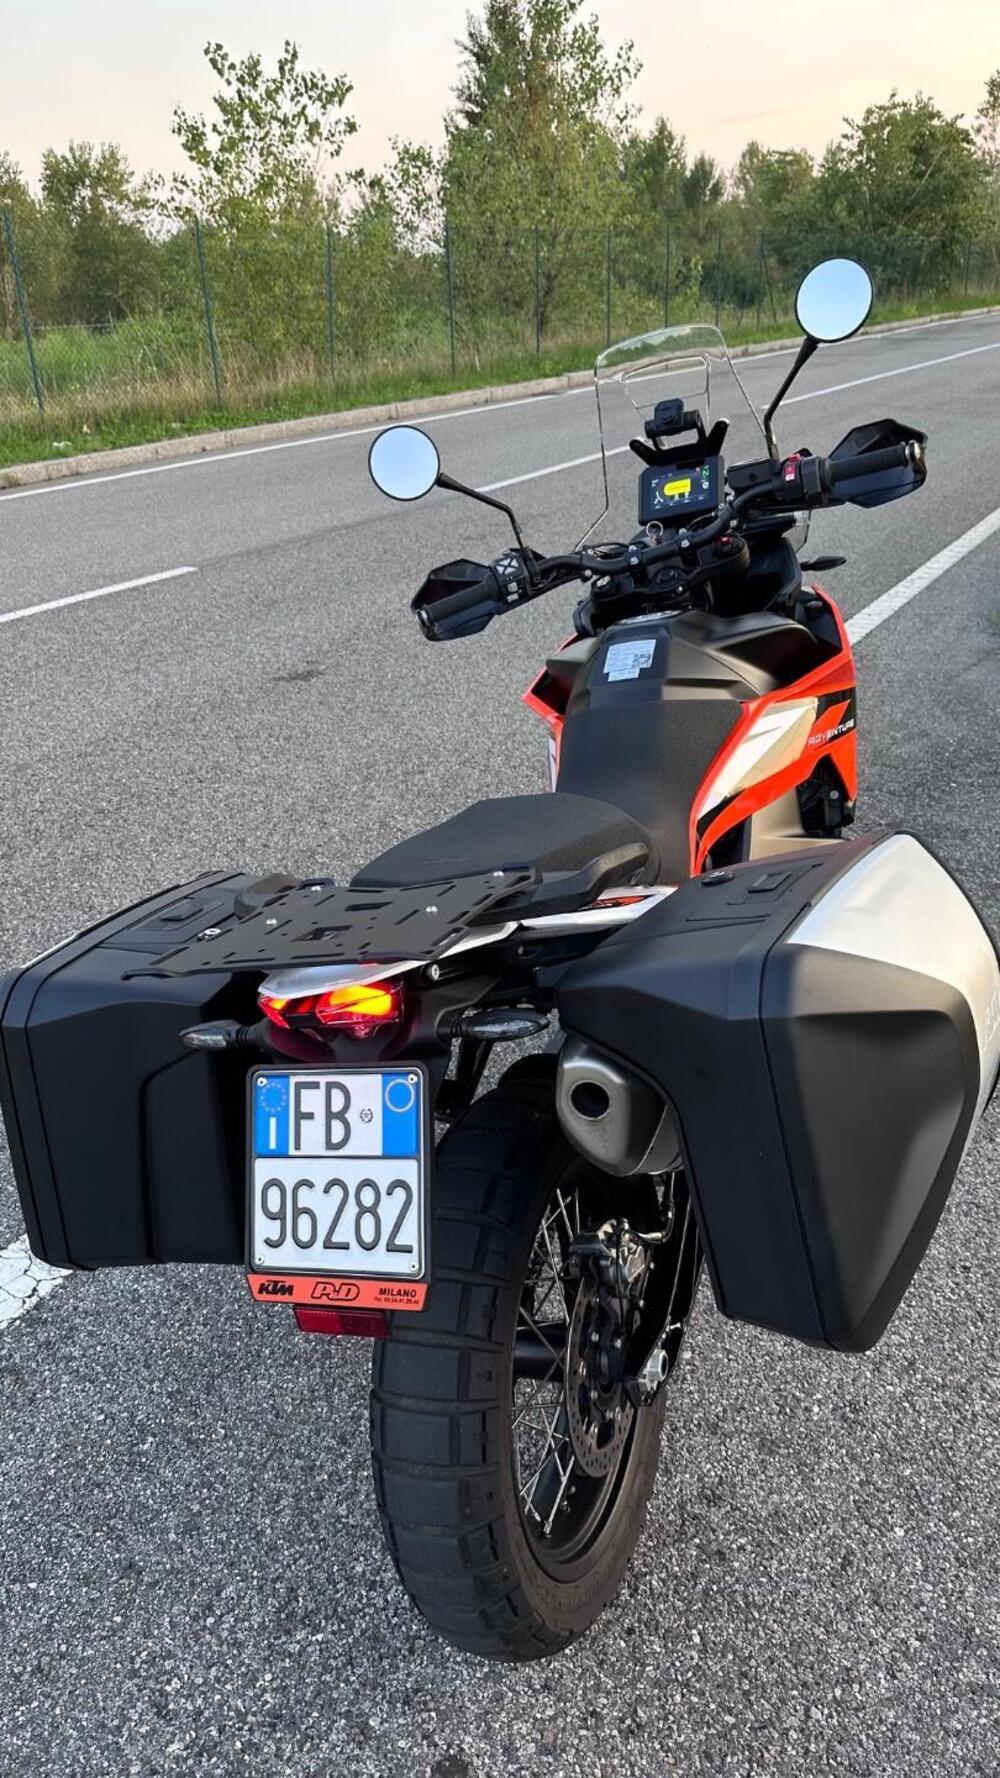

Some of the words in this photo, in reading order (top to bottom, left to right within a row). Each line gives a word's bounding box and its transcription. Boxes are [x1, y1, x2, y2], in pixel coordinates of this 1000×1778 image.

[294, 1081, 352, 1151] FB
[261, 1177, 414, 1253] 96282
[258, 1279, 295, 1296] KTM
[378, 1287, 417, 1298] MILANO
